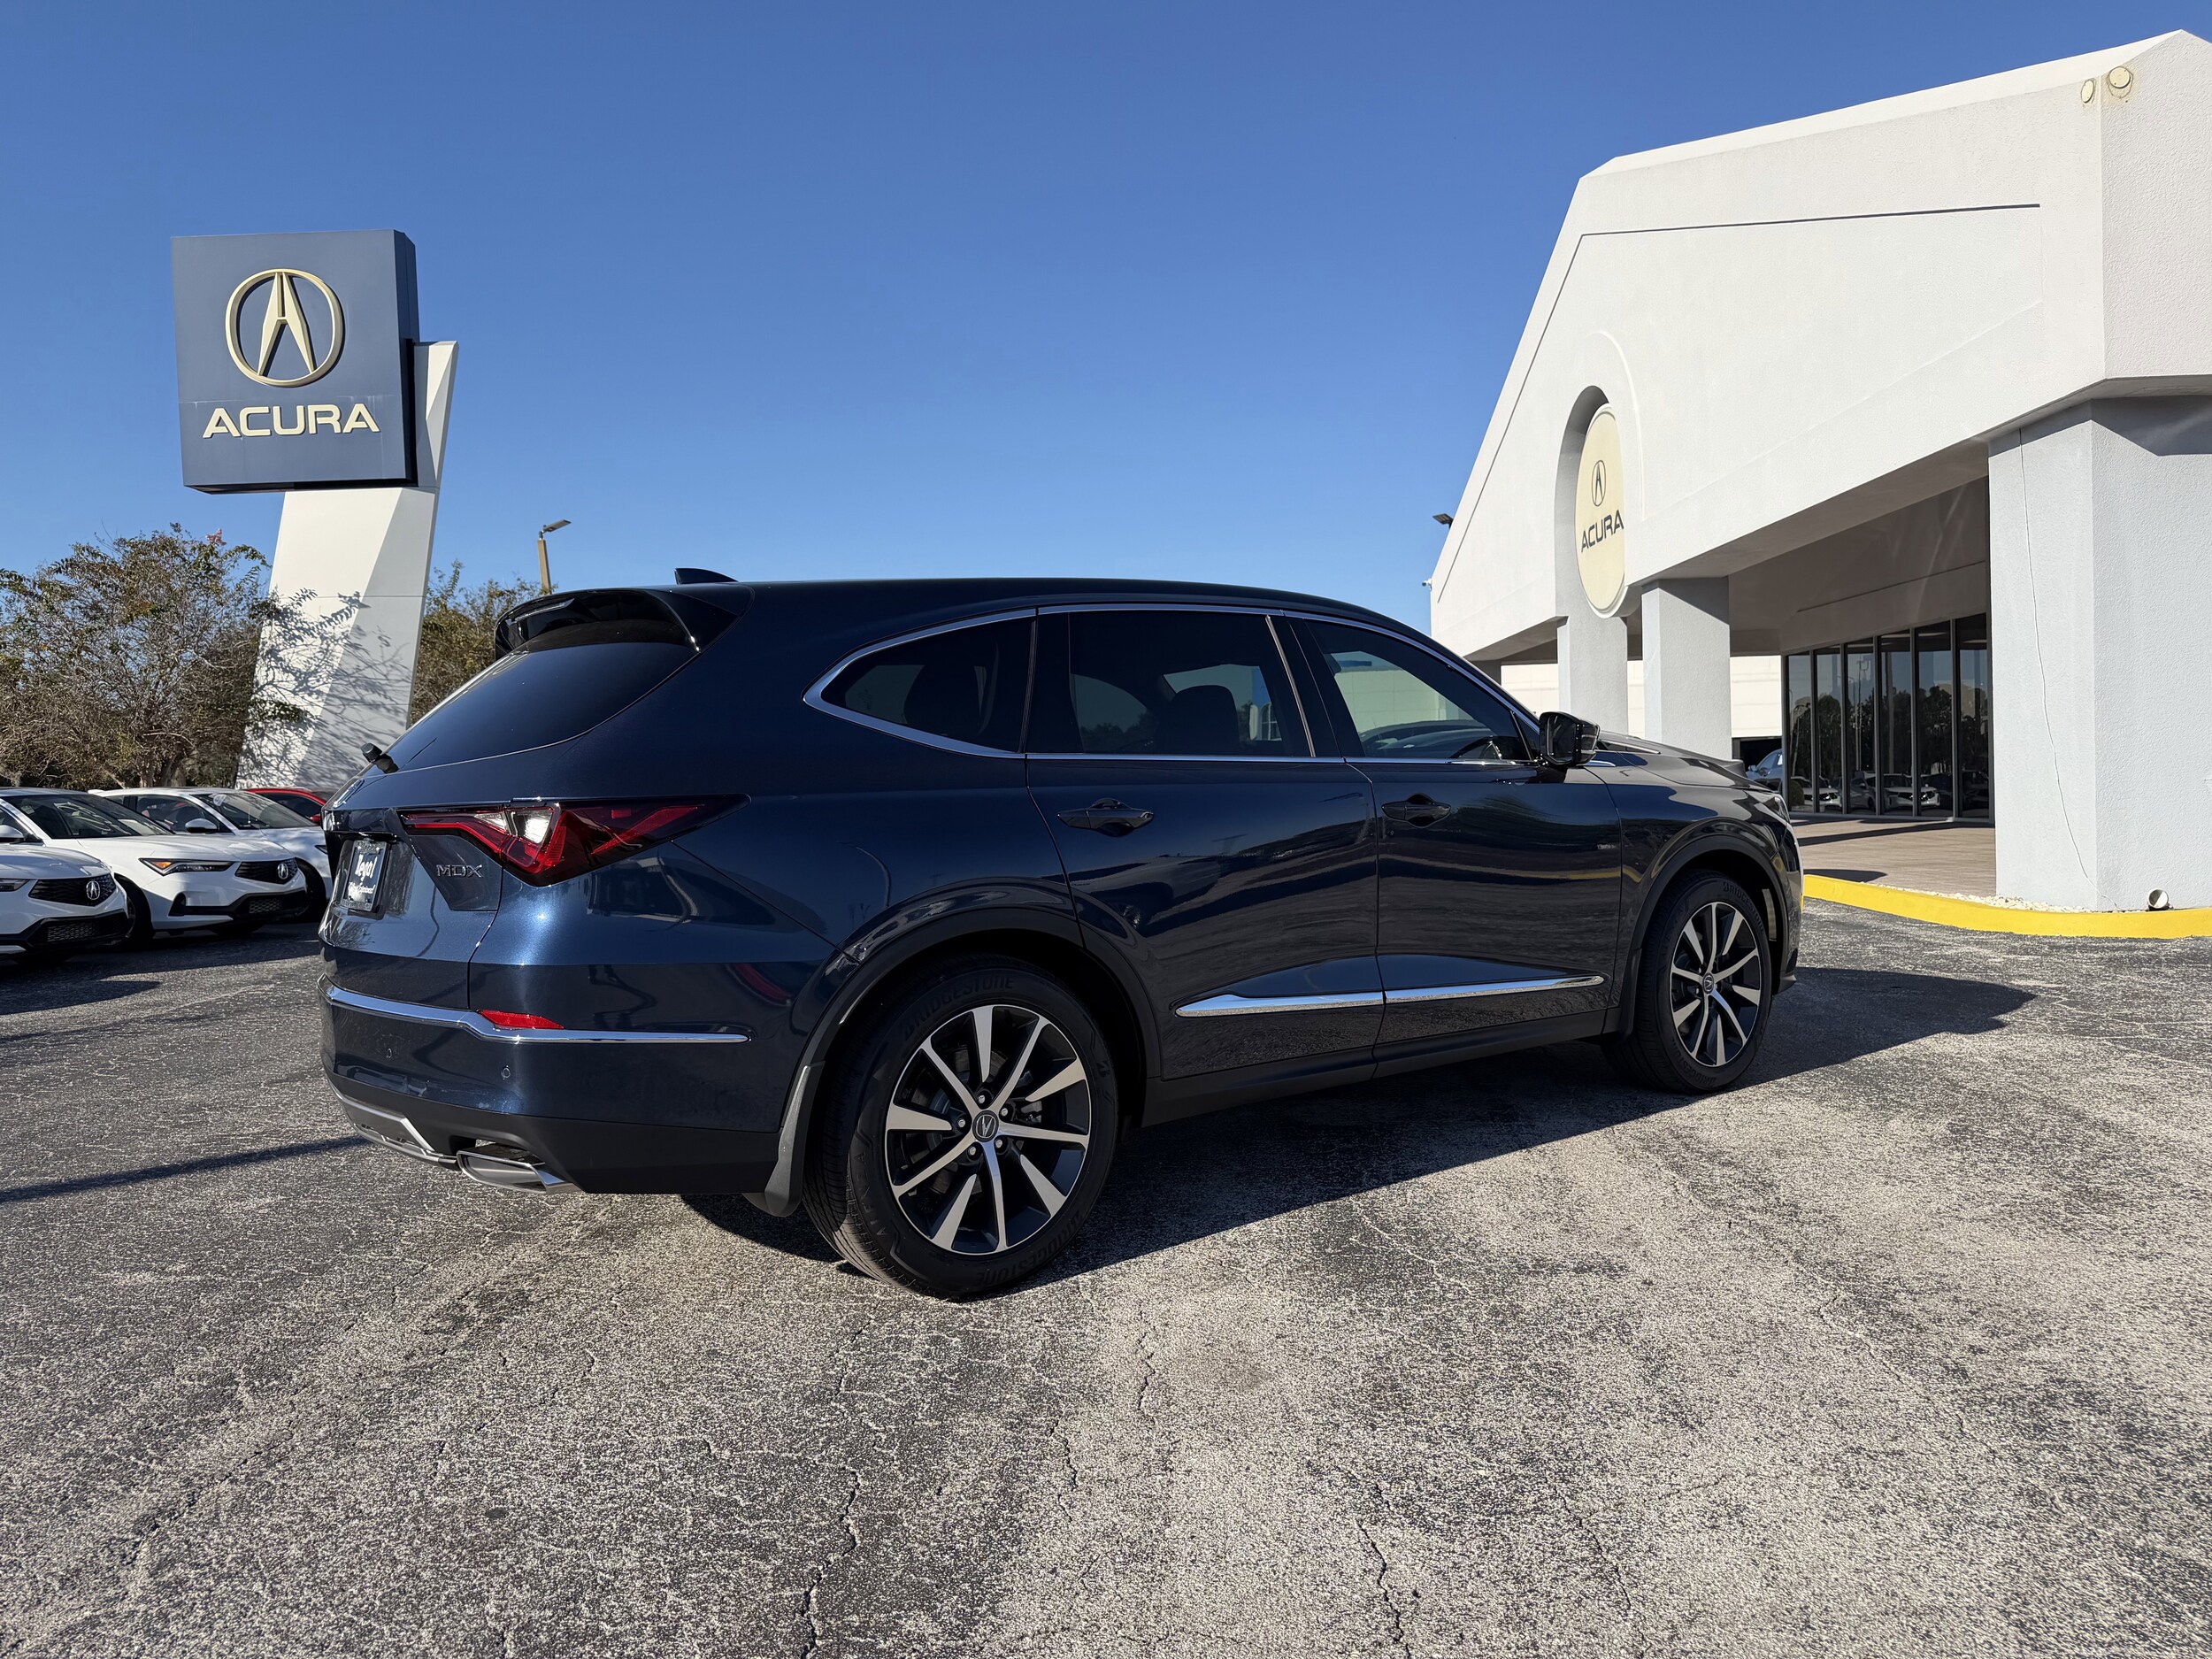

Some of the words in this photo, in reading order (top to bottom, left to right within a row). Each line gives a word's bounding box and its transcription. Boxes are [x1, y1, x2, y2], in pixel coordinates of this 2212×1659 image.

[203, 403, 380, 438] ACURA
[1581, 510, 1624, 553] ACURA
[435, 864, 484, 878] MDX
[902, 975, 1016, 1041] BRIDGESTONE
[973, 1210, 1084, 1288] BRIDGESTONE
